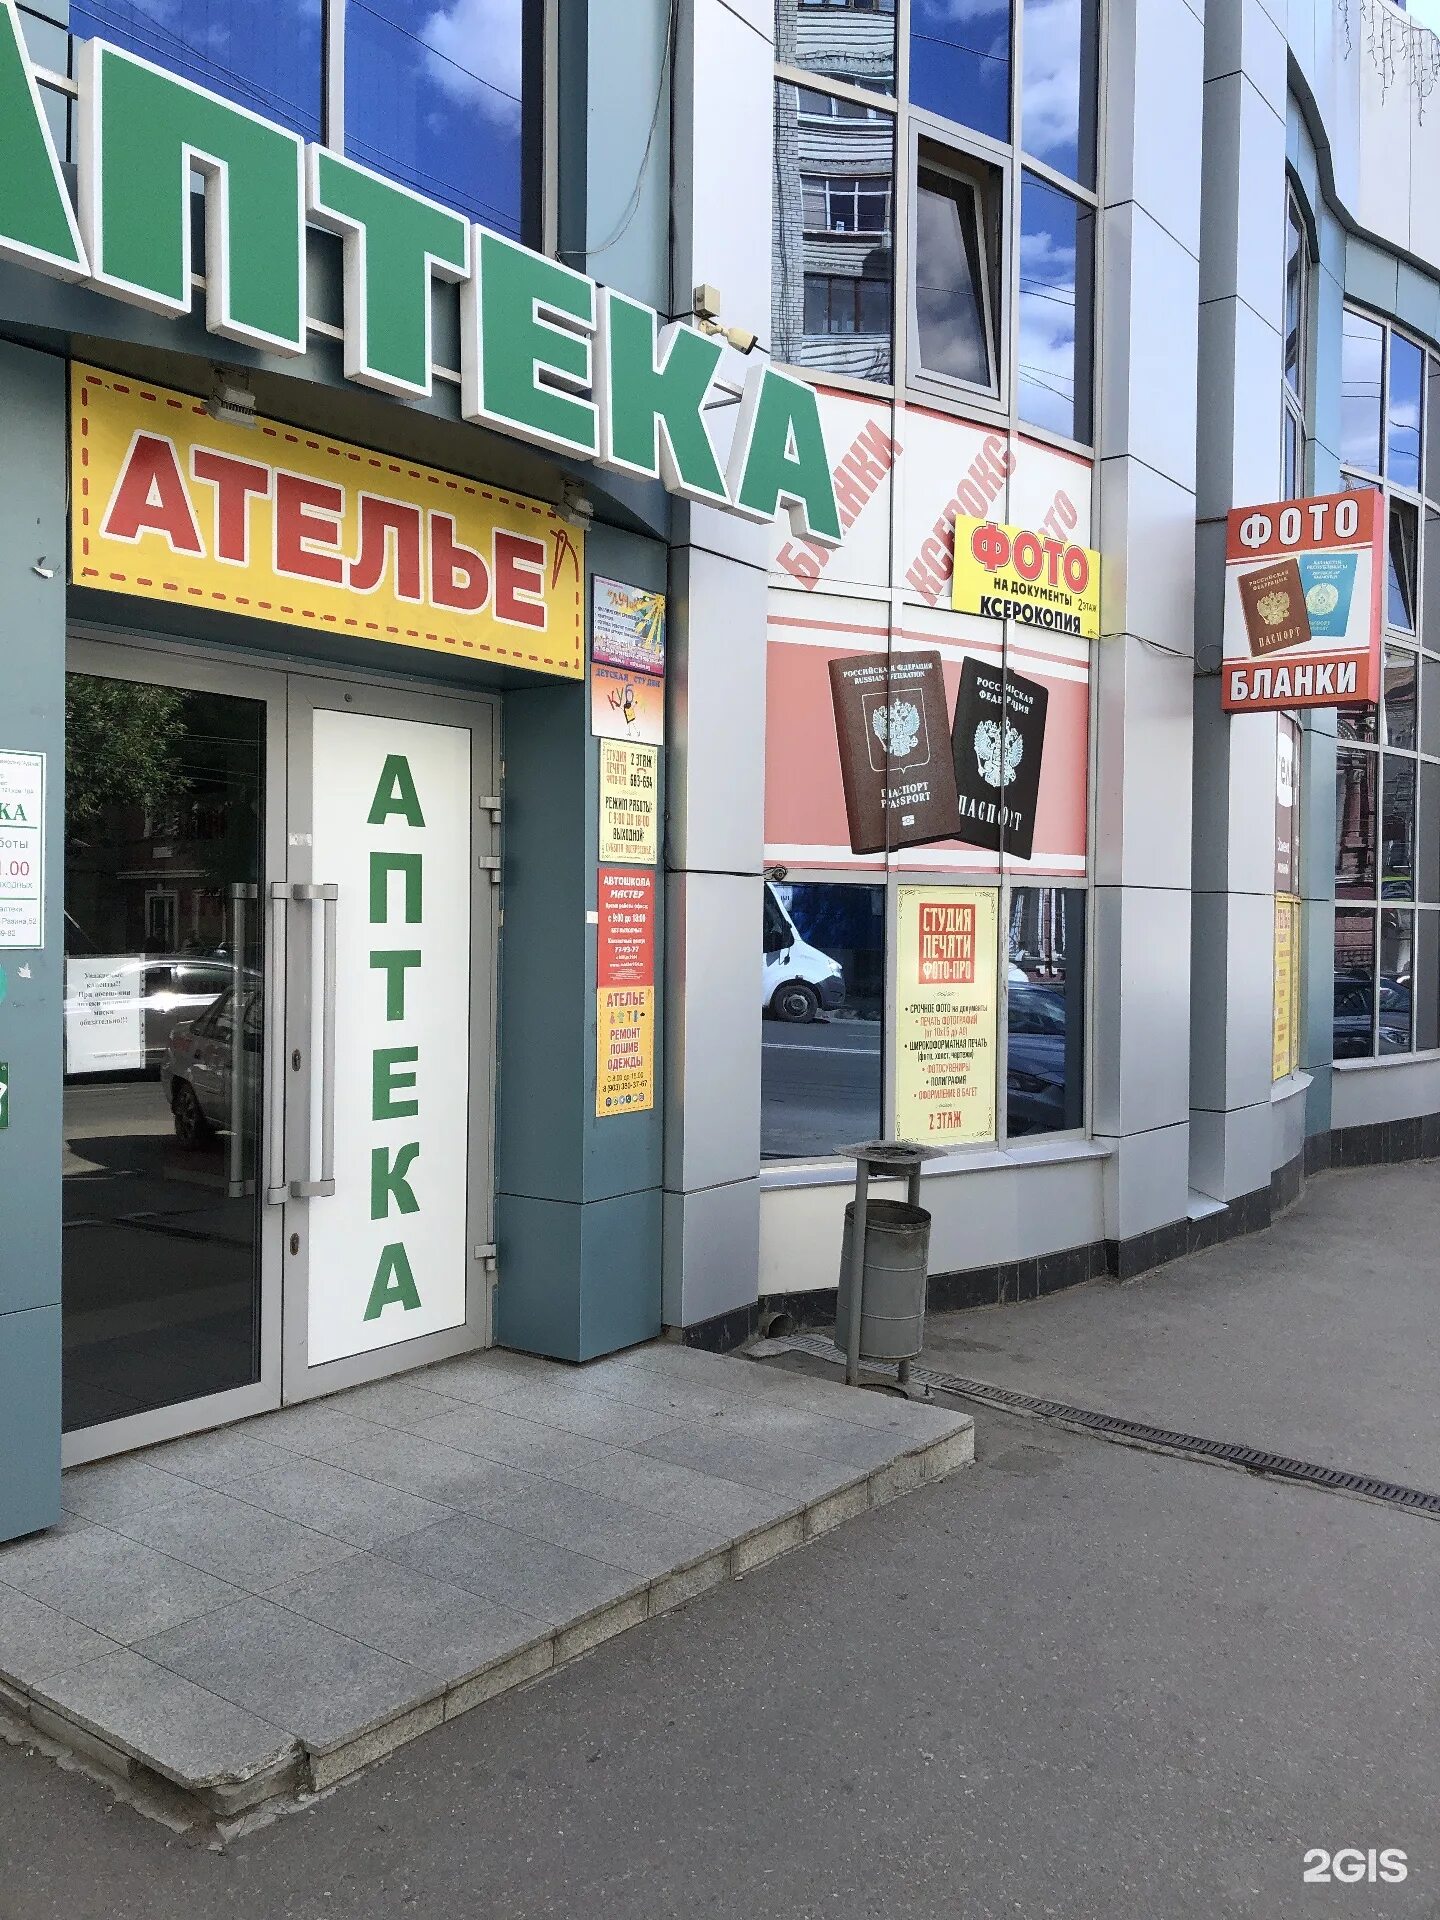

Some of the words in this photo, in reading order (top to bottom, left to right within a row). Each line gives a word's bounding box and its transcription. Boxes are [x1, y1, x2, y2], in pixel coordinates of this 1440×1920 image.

[1039, 489, 1078, 541] ТО
[100, 429, 547, 631] АТЕЛЬЕ
[1239, 499, 1359, 548] ФОТО
[971, 521, 1090, 594] ФОТО
[994, 577, 1008, 591] НА
[1011, 580, 1072, 606] ДОКУМЕНТЫ
[980, 596, 1081, 633] КСЕРОКОПИЯ
[1258, 627, 1300, 647] ПАСПОРТ
[842, 664, 895, 678] РОССИЙСКАЯ
[897, 663, 933, 671] ФЕДЕРАЦИЯ
[854, 674, 885, 685] RUSSIAN
[1230, 661, 1357, 702] БЛАНКИ
[631, 753, 635, 766] 2
[636, 753, 652, 768] ЭТАЖ
[605, 796, 628, 810] РЕЖИМ
[881, 792, 931, 808] PASSPORT
[603, 876, 651, 887] АВТОШКОЛА
[610, 890, 644, 899] МАСТЕР
[624, 915, 631, 924] до
[923, 907, 971, 932] СТУДИЯ
[922, 960, 971, 980] ФОТО-ПРО
[606, 991, 645, 1008] АТЕЛЬЕ
[910, 1004, 934, 1013] СРОЧНОЕ
[935, 1003, 951, 1013] ФОТО
[920, 1016, 940, 1026] ПЕЧАТЬ
[363, 754, 426, 1321] АПТЕКА
[610, 1028, 640, 1040] РЕМОНТ
[610, 1042, 639, 1055] ПОШИВ
[909, 1039, 967, 1050] ШИРОКОФОРМАТНАЯ
[967, 1038, 988, 1048] ПЕЧАТЬ
[607, 1056, 643, 1071] ОДЕЖДЫ
[930, 1075, 967, 1086] ПОЛИГРАФИЯ
[929, 1113, 934, 1130] 2
[937, 1111, 962, 1129] ЭТАЖ
